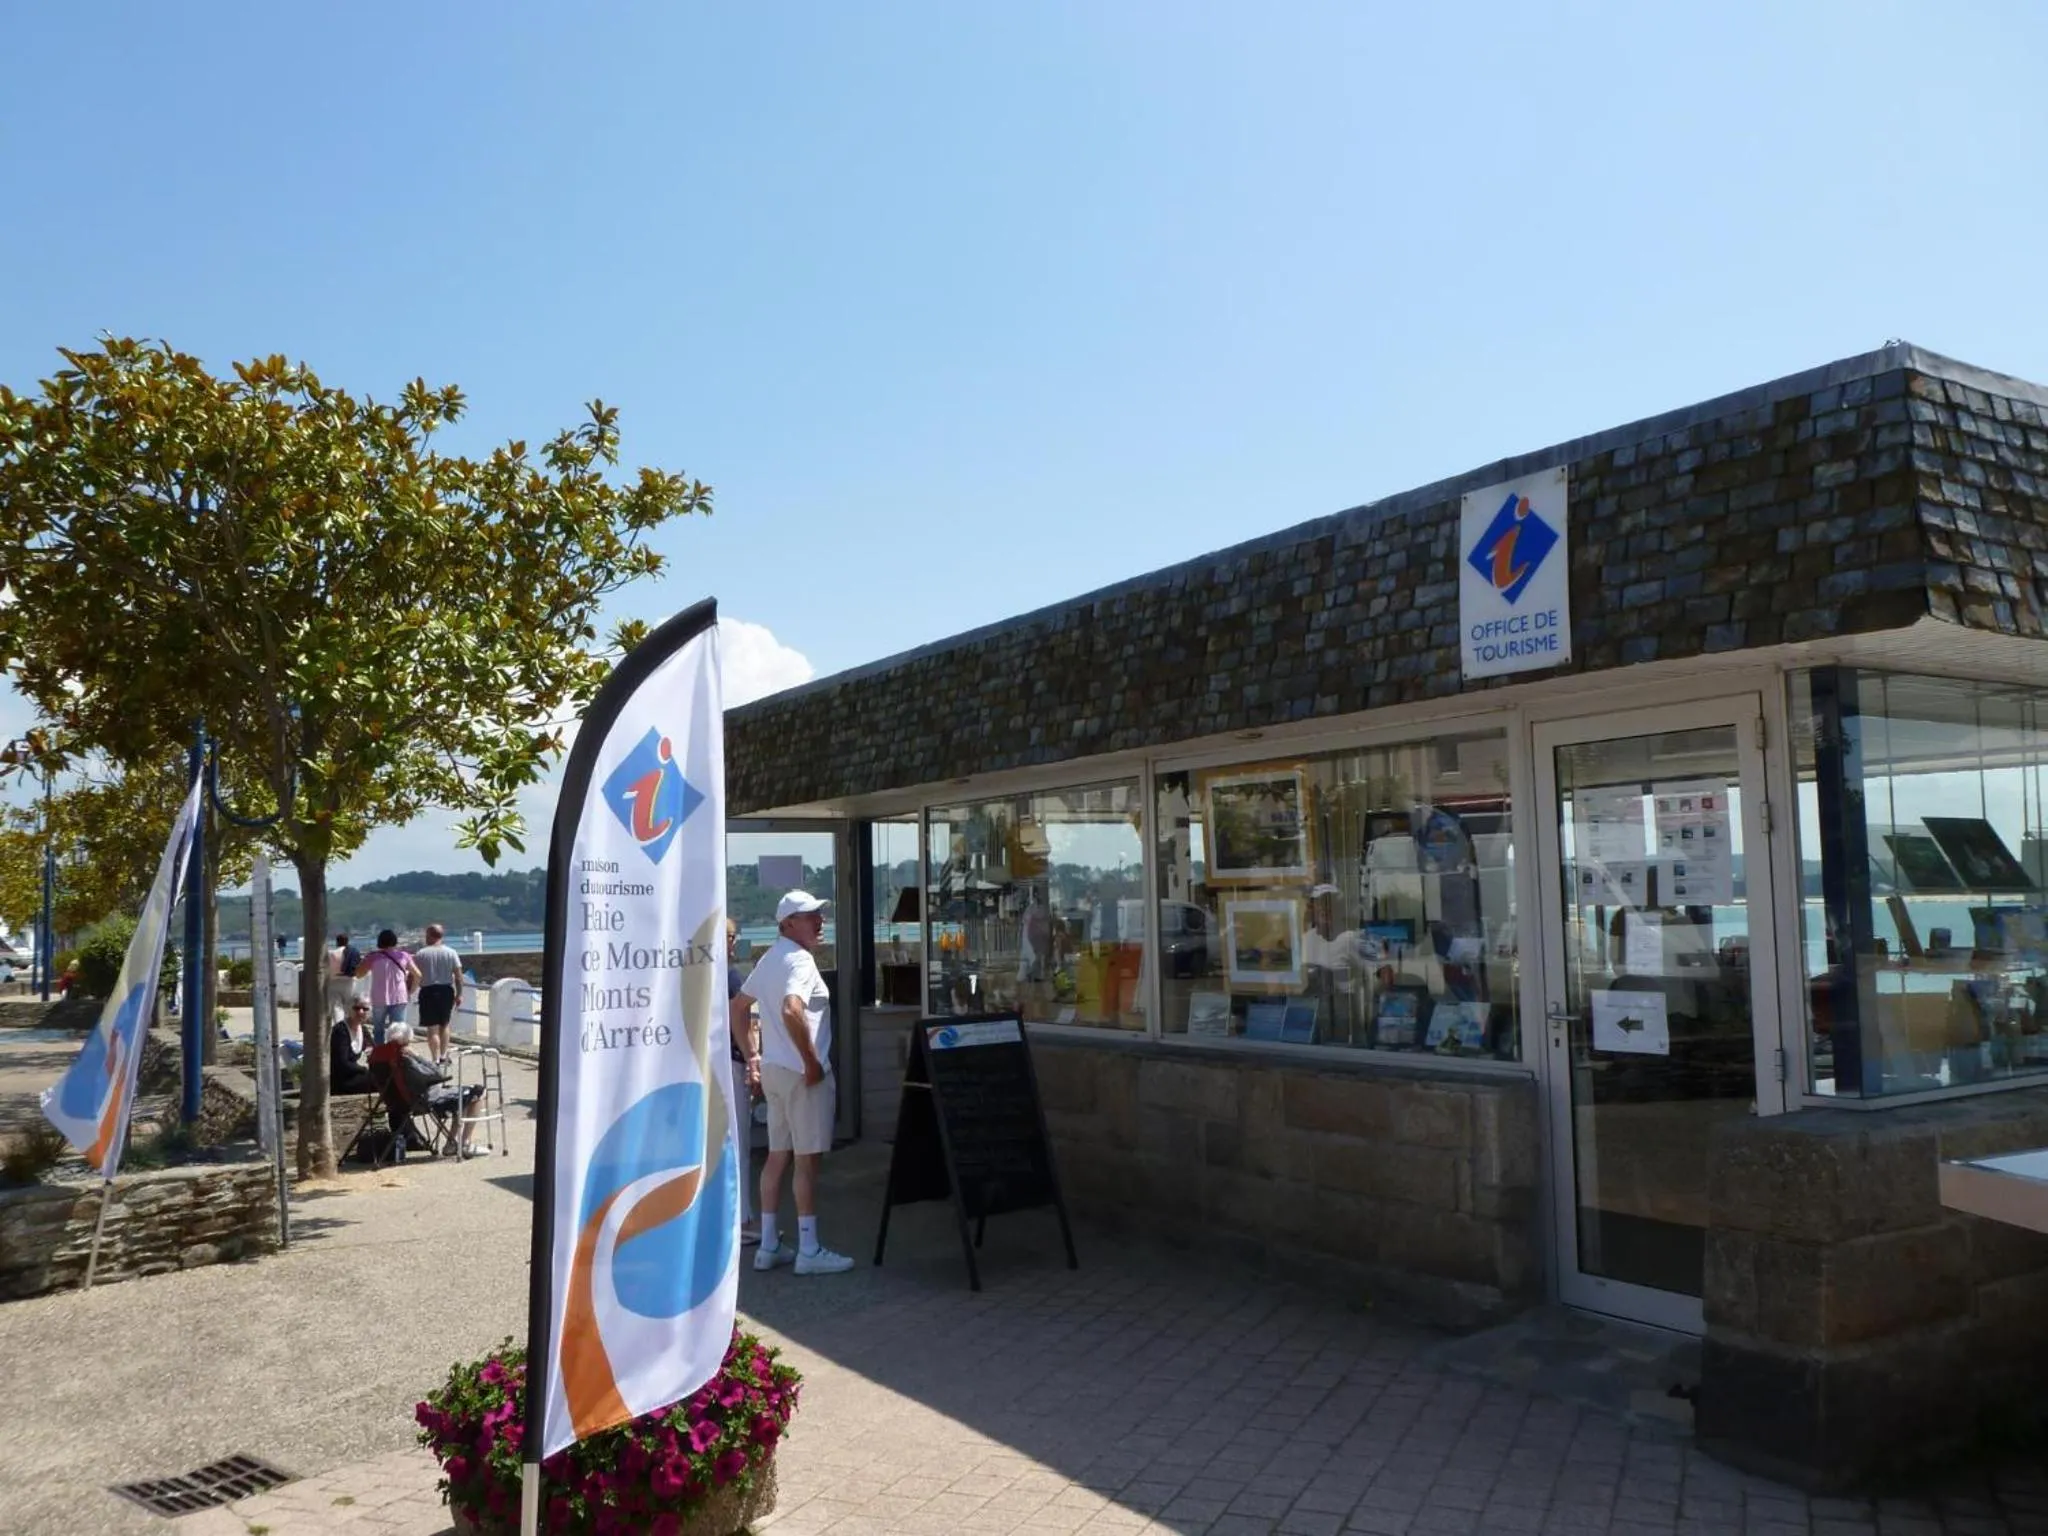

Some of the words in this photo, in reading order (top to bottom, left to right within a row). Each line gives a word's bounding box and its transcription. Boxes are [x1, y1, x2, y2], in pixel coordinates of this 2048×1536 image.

[1471, 615, 1528, 641] OFFICE
[1534, 610, 1558, 629] DE
[1473, 633, 1559, 663] TOURISME
[605, 939, 715, 971] Morlaix
[580, 982, 651, 1012] Monts
[581, 1017, 672, 1053] d'Arrée
